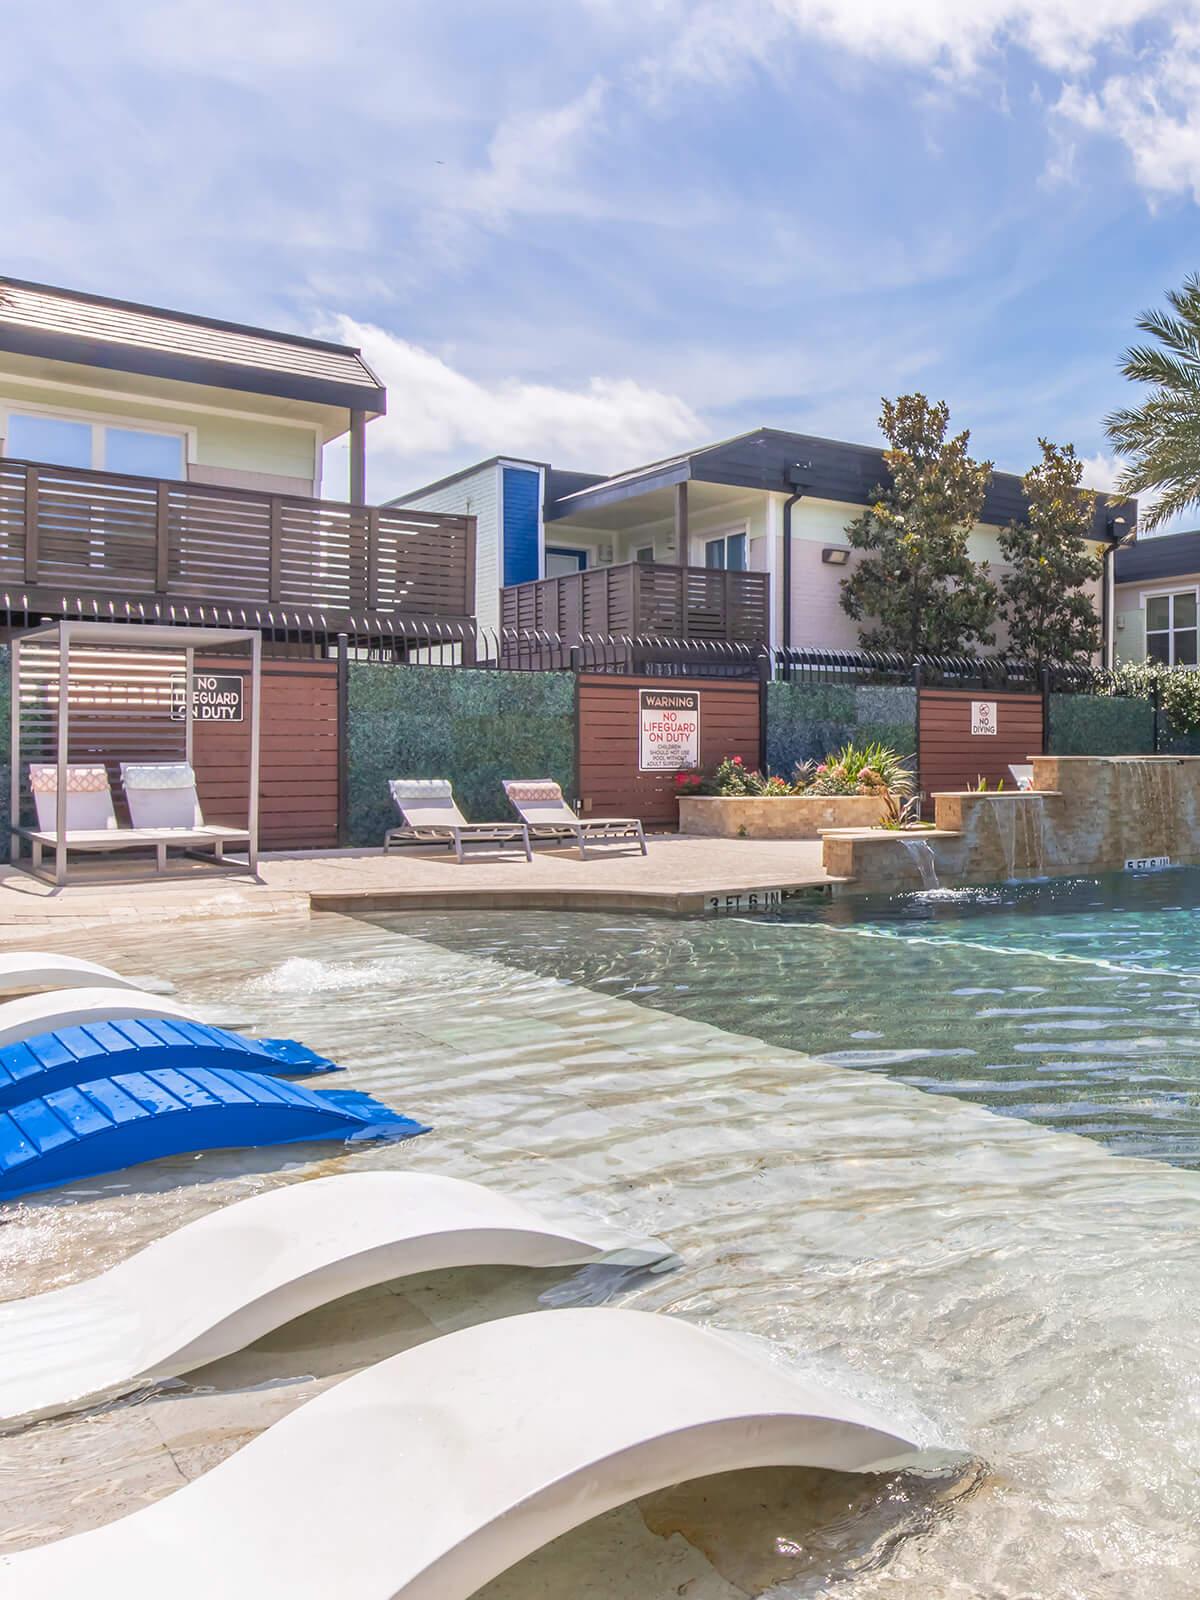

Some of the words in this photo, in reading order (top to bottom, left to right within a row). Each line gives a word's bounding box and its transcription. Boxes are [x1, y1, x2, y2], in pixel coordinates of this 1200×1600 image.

[198, 678, 217, 690] NO
[174, 691, 239, 705] LIEGUARD
[646, 696, 694, 708] WARNING
[202, 706, 236, 719] DUTY
[663, 712, 677, 722] NO
[644, 722, 696, 733] LIFEGUARD
[979, 718, 989, 726] NO
[973, 725, 995, 734] DIVING
[649, 733, 663, 742] ON
[666, 733, 690, 742] DUTY
[726, 894, 742, 906] FT
[749, 893, 758, 905] 6
[764, 891, 779, 905] IN
